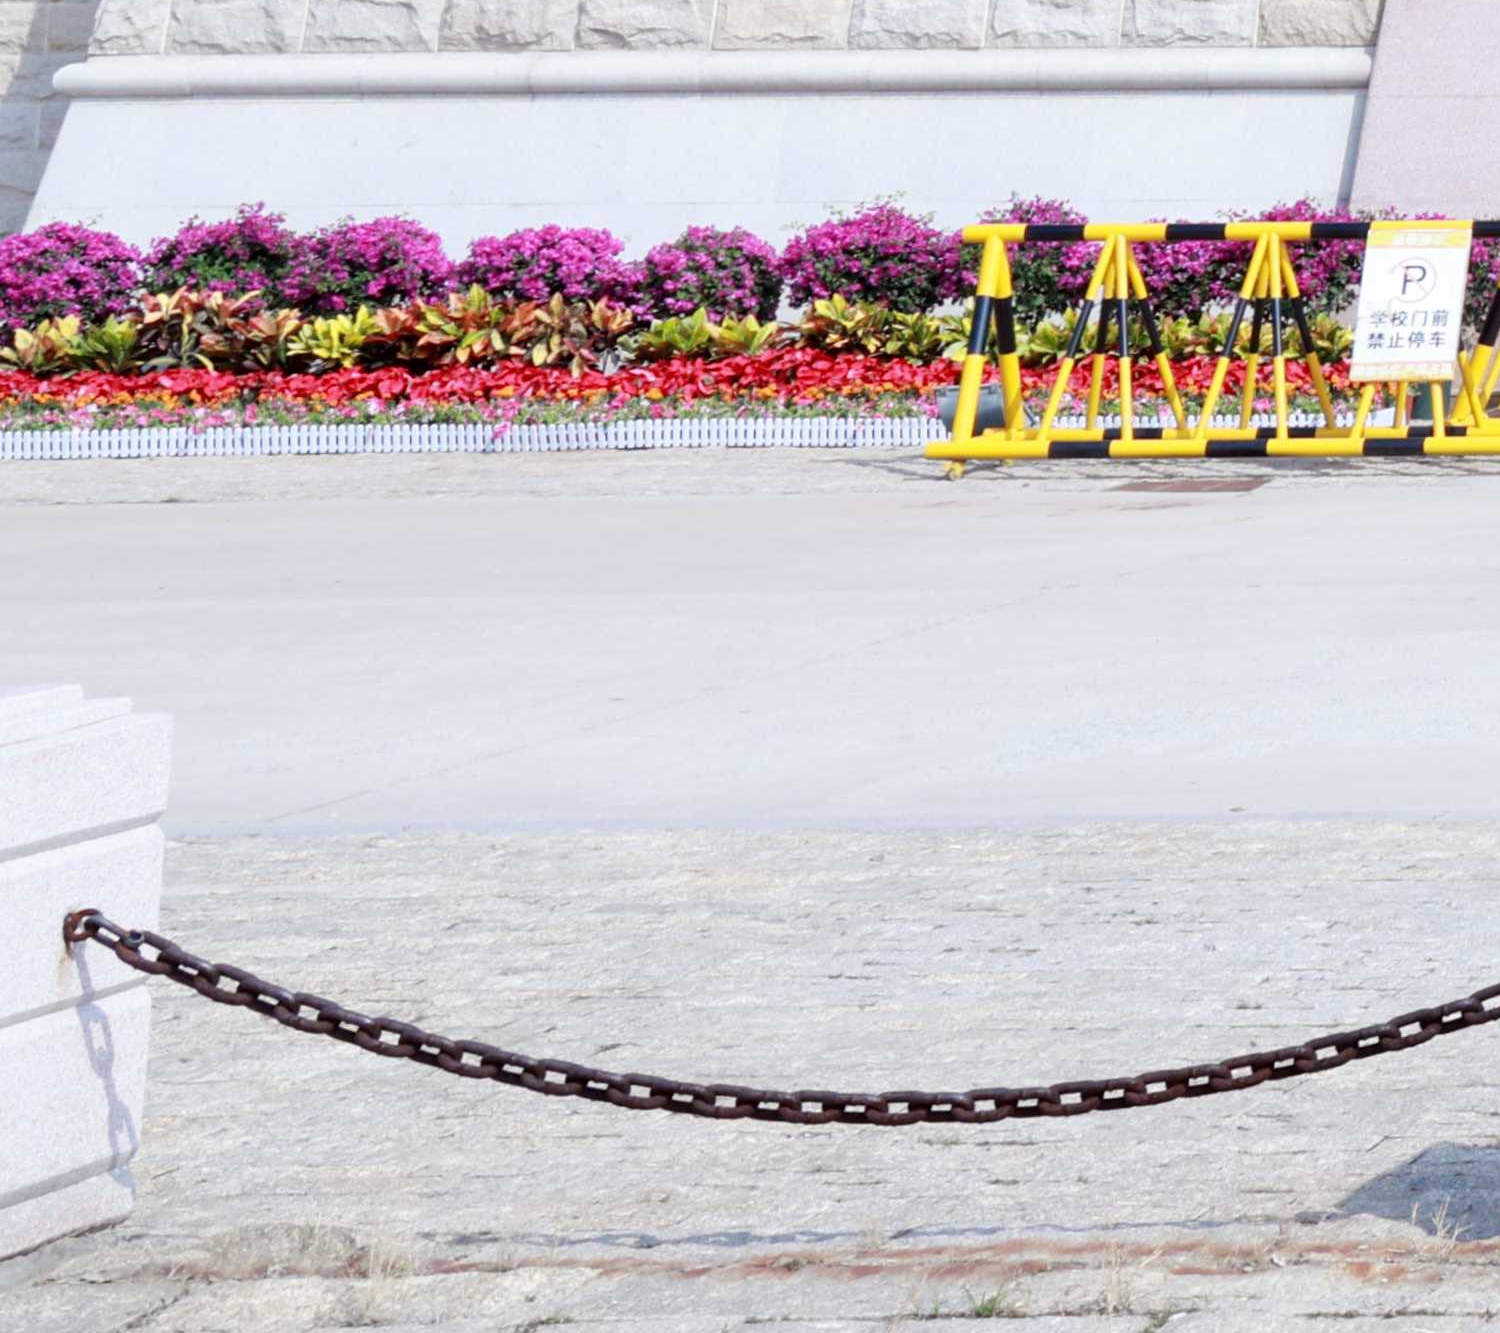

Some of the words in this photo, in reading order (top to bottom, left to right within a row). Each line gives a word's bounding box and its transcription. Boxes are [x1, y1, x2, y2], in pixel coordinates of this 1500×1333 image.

[1401, 265, 1427, 296] P
[1369, 309, 1449, 328] 学校门前
[1367, 331, 1446, 350] 禁止停车
